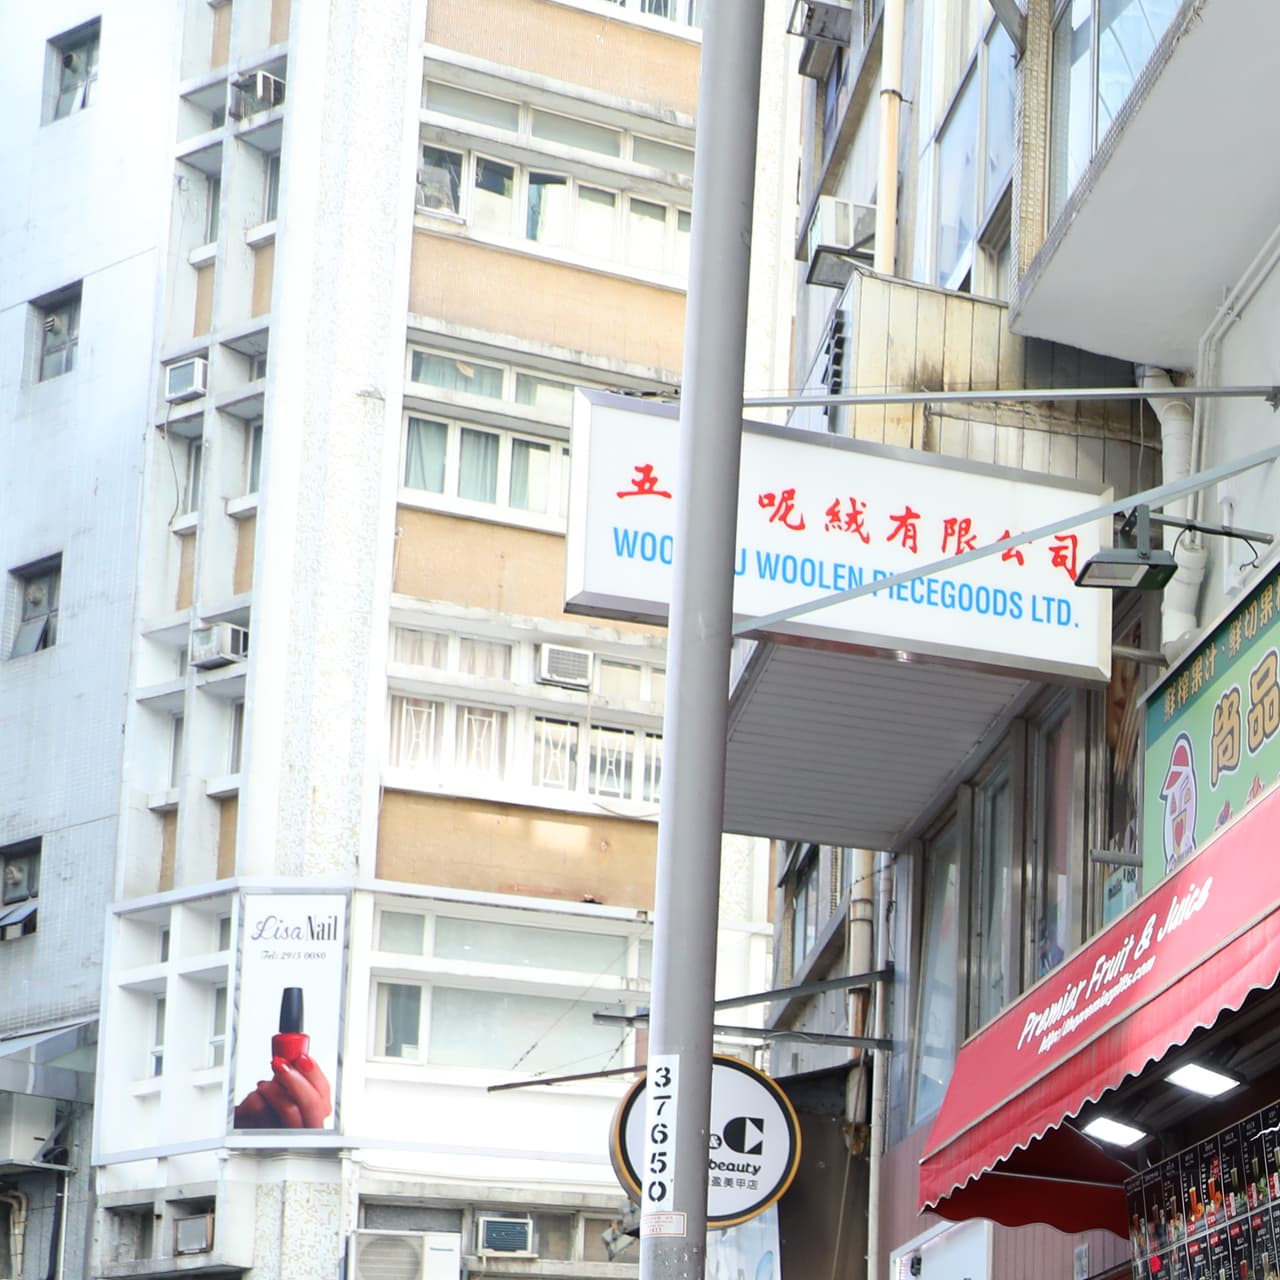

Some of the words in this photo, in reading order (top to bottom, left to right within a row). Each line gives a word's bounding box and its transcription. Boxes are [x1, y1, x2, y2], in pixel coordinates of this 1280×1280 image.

[616, 463, 1079, 581] 五呢絨有限公司
[756, 550, 865, 592] WOOLEN
[1030, 595, 1080, 628] LTD.
[251, 915, 304, 941] Lisa
[306, 915, 338, 941] Nail
[1017, 979, 1088, 1050] Premier
[1085, 933, 1135, 999] Fruit
[1156, 876, 1214, 943] Juice
[647, 1066, 672, 1203] 37650
[708, 1159, 762, 1176] beauty
